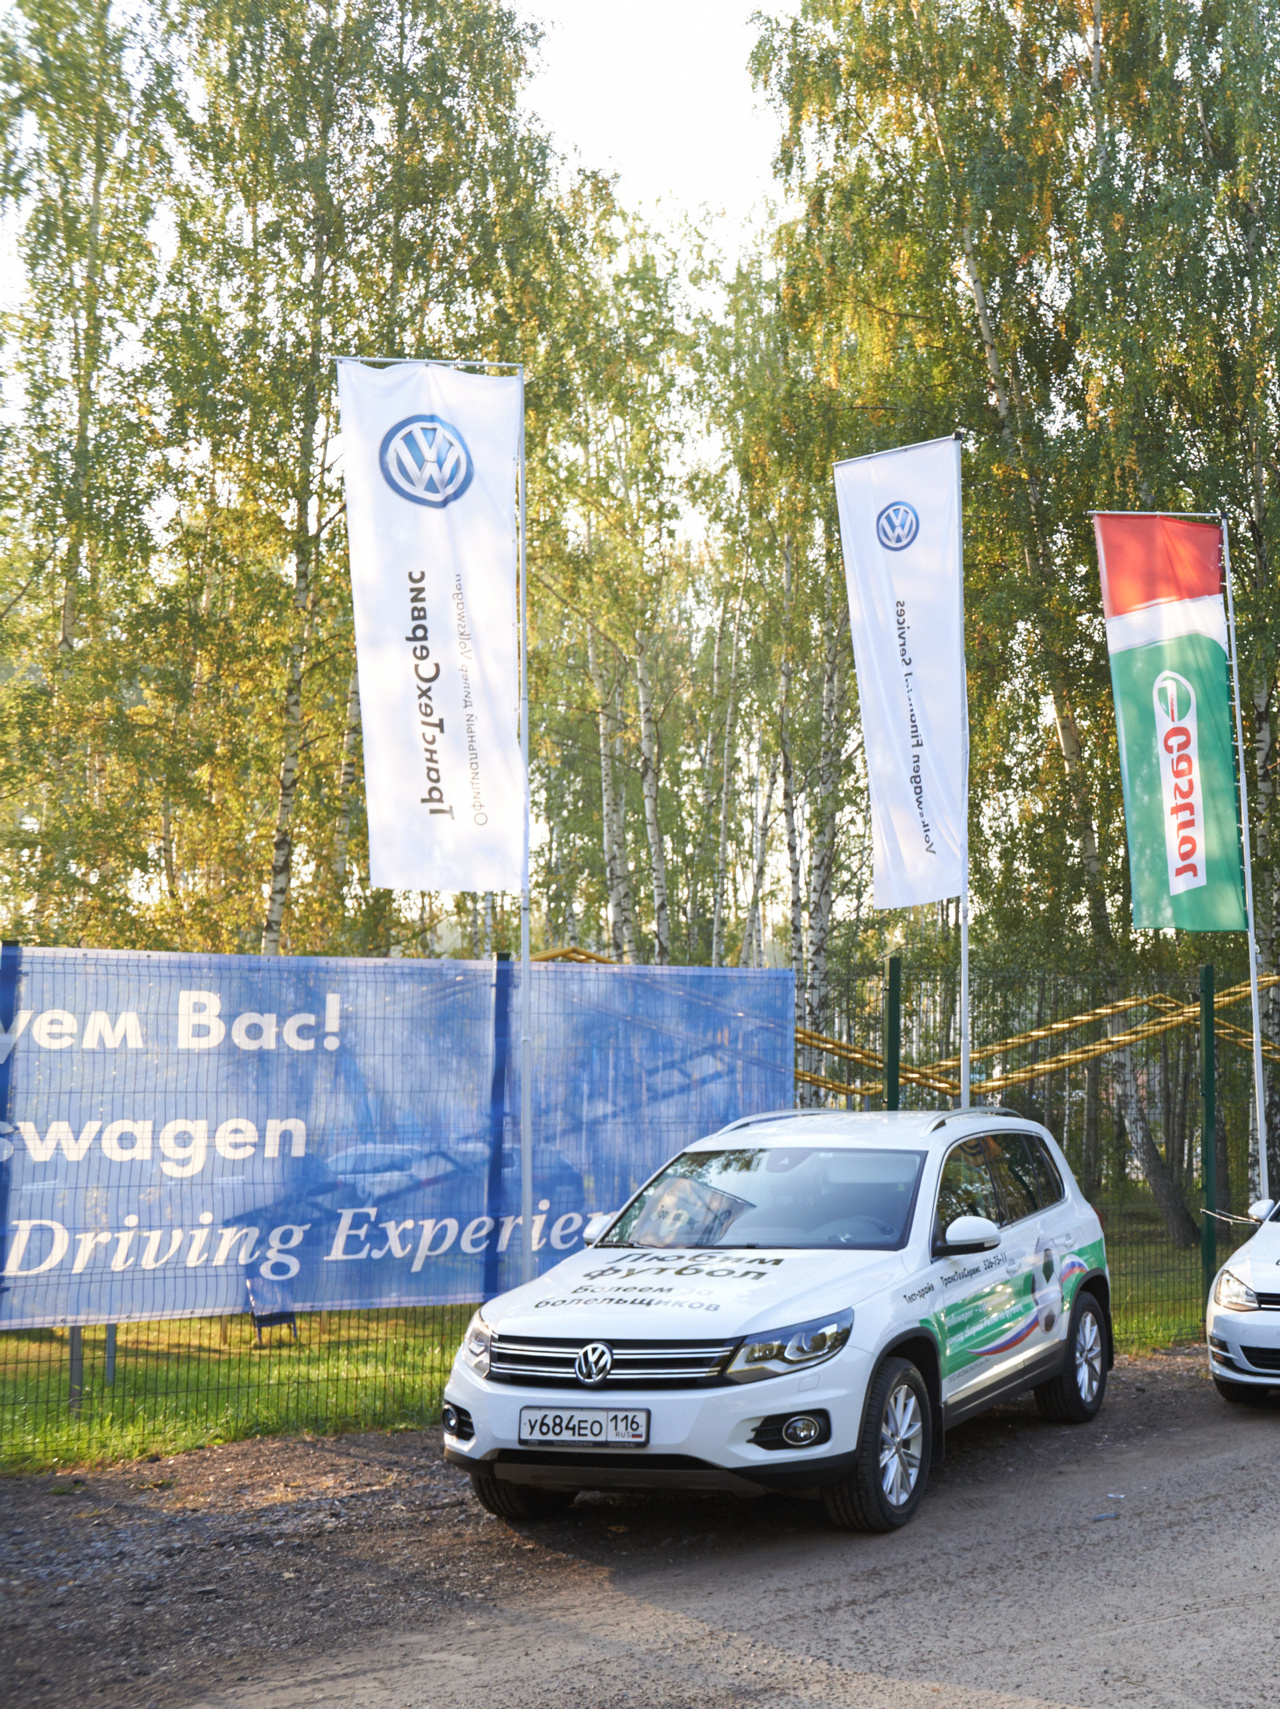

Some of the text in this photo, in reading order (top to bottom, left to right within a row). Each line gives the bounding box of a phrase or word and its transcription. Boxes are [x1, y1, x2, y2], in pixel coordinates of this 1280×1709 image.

[177, 990, 341, 1051] Вас!
[0, 1211, 312, 1281] Driving
[606, 1252, 784, 1266] Любим
[583, 1263, 769, 1281] футбол
[571, 1284, 673, 1294] Болеем
[534, 1296, 721, 1312] болельщиков
[528, 1414, 640, 1437] У684ЕО 116
[615, 1431, 631, 1439] RUS
